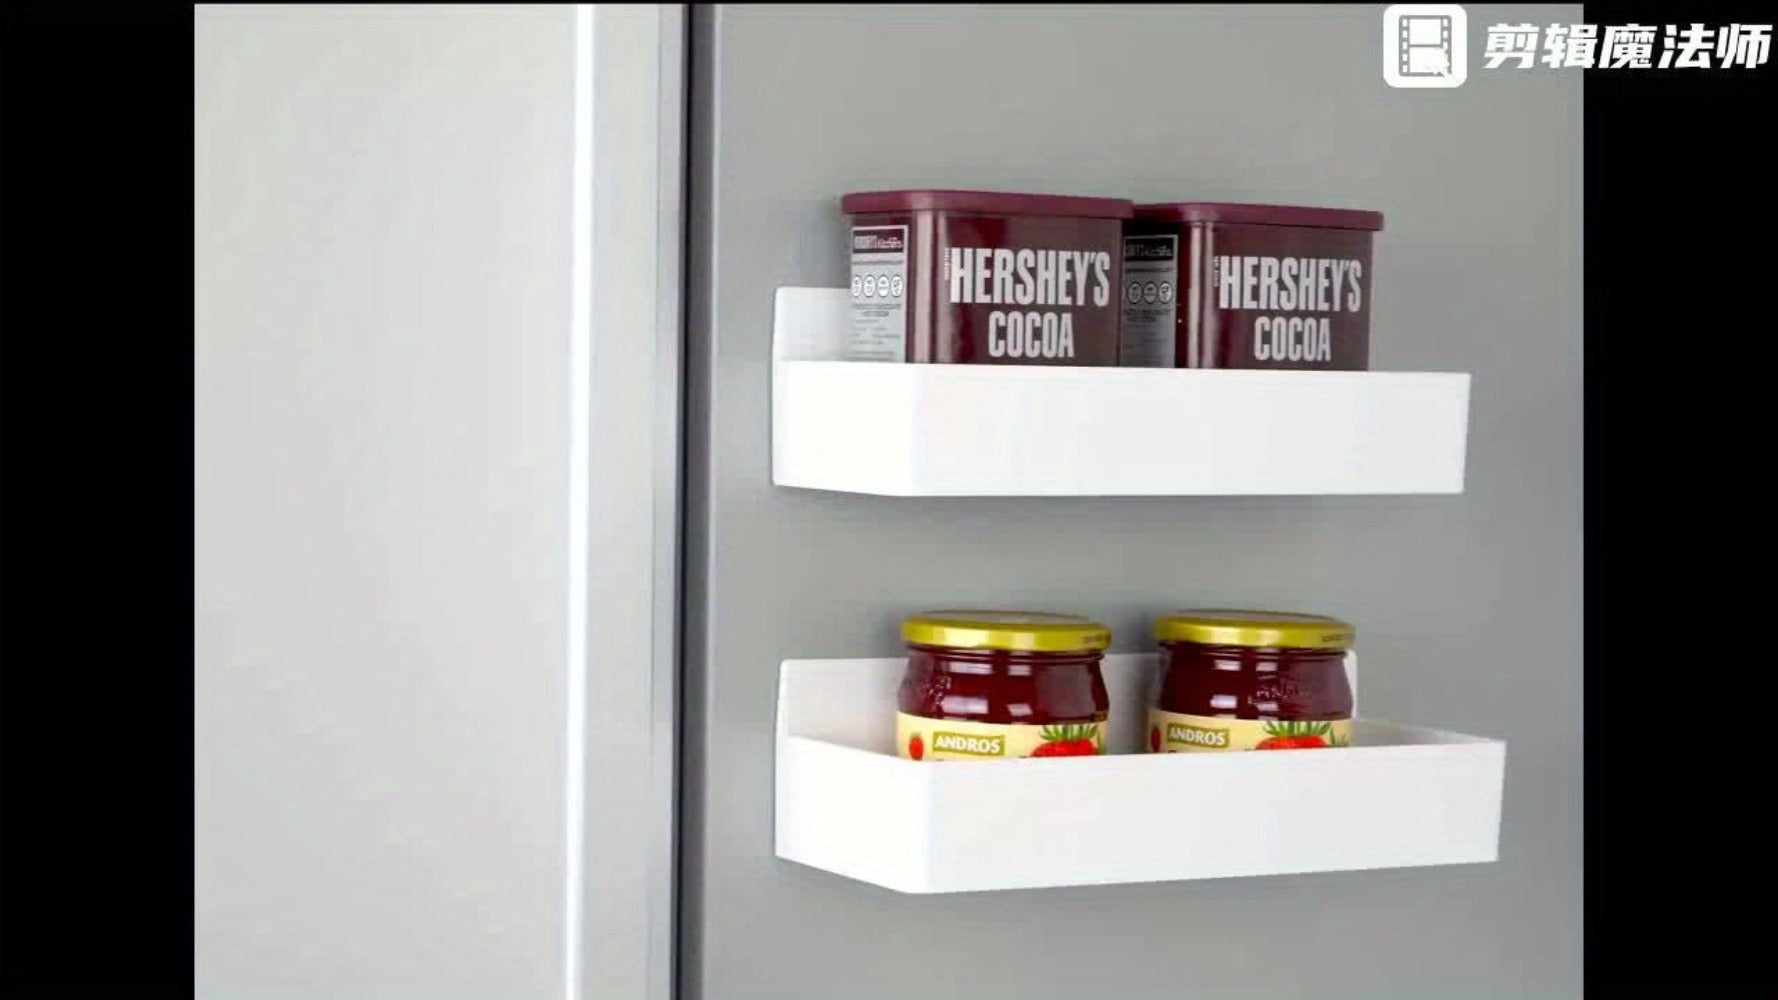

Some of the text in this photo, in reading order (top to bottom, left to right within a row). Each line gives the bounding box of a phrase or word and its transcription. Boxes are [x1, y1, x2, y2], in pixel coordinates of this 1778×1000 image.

[950, 247, 1111, 307] HERSHEY'S
[1219, 256, 1362, 312] HERSHEY'S
[988, 311, 1075, 358] COCOA
[1253, 316, 1332, 362] COCOA
[934, 734, 1001, 754] ANDROS
[1168, 726, 1226, 746] ANDROS
